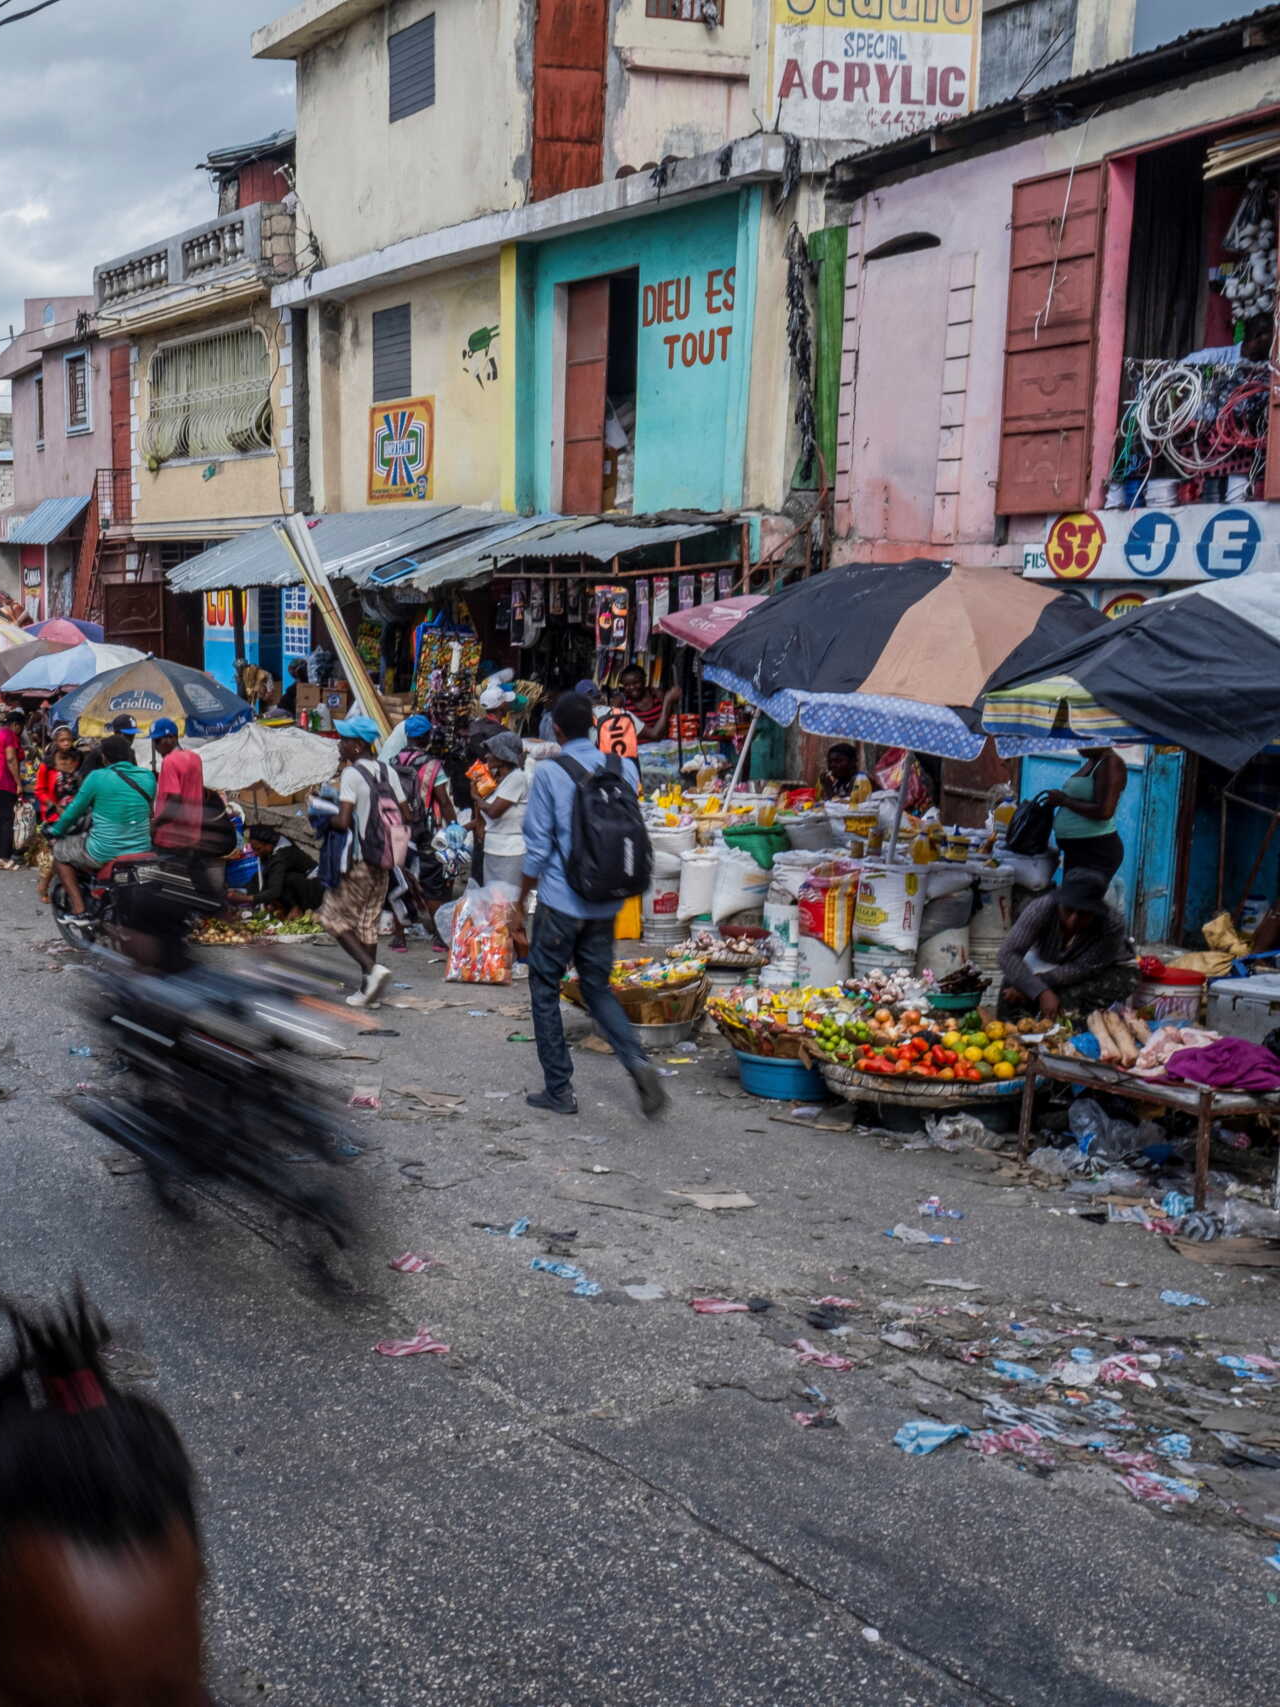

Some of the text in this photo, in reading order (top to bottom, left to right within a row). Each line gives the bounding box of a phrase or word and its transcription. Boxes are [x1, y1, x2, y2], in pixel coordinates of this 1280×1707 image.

[843, 32, 907, 60] SPECIAL
[777, 58, 966, 107] ACRYLIC
[642, 275, 691, 327] DIEU
[663, 326, 733, 369] TOUT
[109, 698, 163, 711] Criollito
